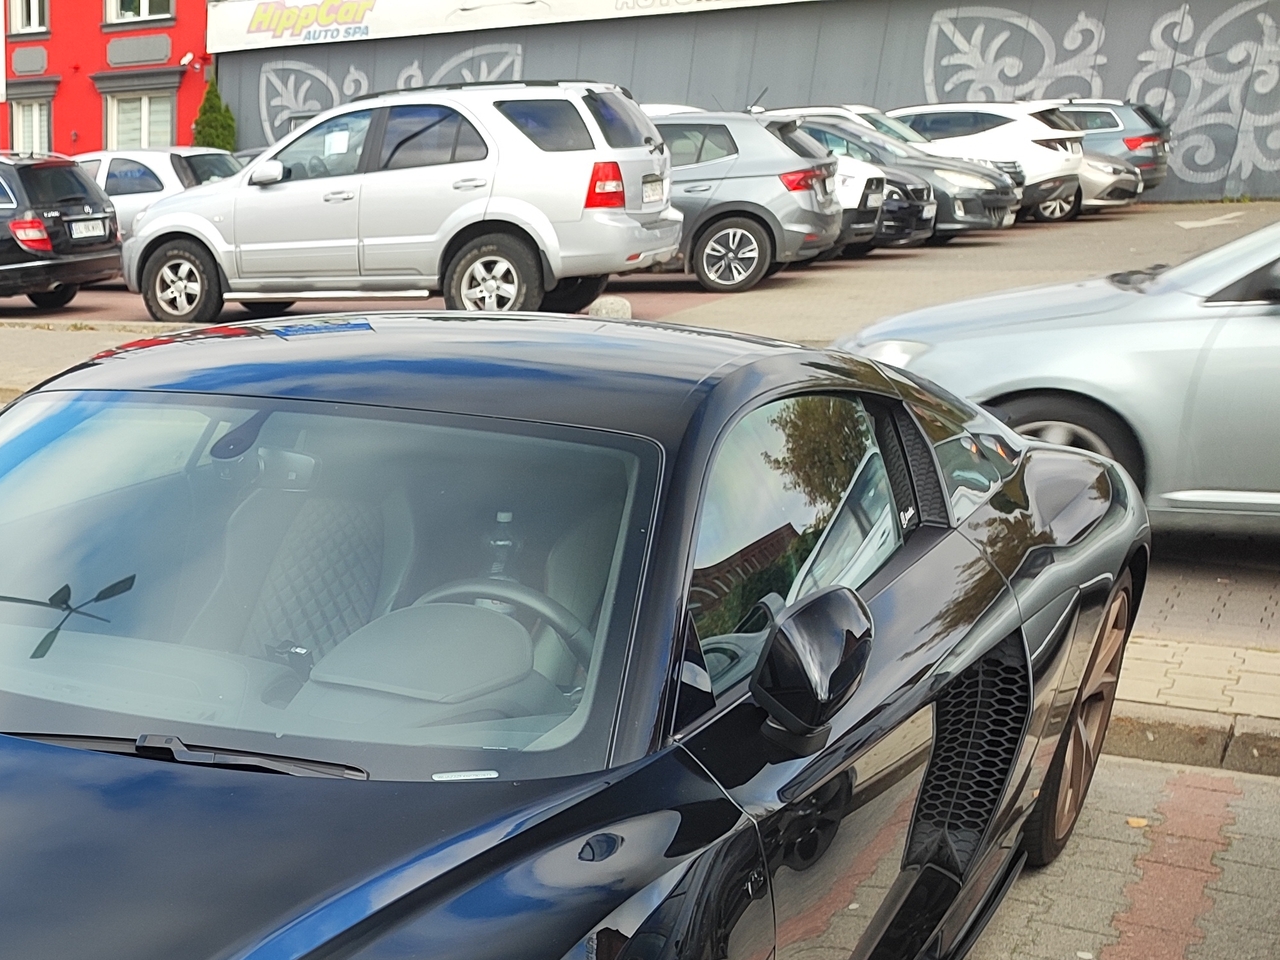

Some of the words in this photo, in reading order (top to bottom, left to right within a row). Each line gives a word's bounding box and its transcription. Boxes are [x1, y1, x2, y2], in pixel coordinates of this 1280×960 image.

[247, 0, 376, 39] HippCar
[302, 27, 340, 42] AUTO
[342, 25, 370, 39] SPA
